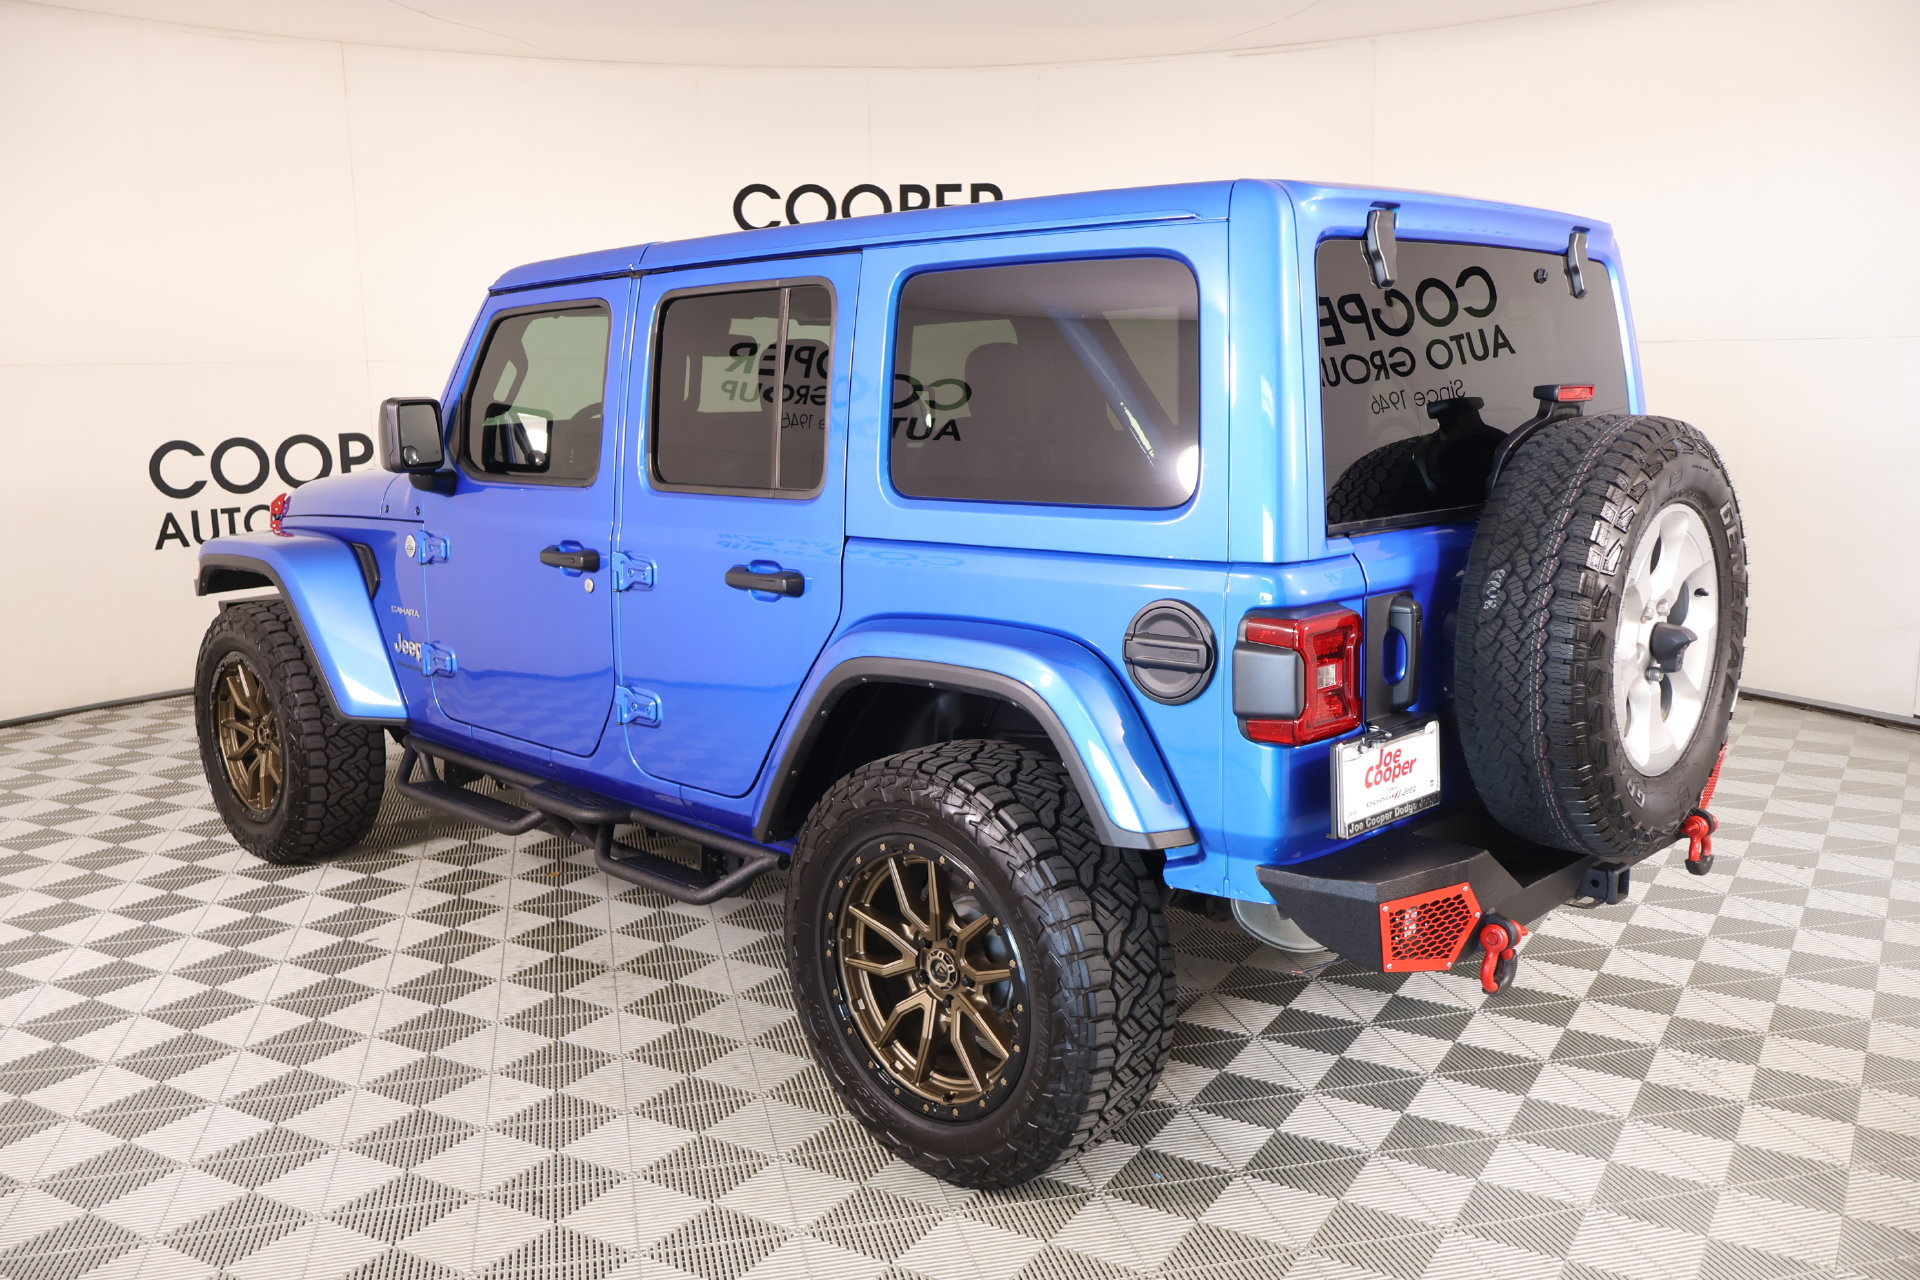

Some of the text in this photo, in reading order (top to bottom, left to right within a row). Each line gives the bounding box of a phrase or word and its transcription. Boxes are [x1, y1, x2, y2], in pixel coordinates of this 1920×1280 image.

[390, 605, 420, 618] SAHARA
[394, 632, 422, 662] Jeep
[1375, 748, 1402, 770] Joe
[1365, 758, 1417, 789] Cooper
[1349, 823, 1364, 834] Joe
[1365, 811, 1393, 828] Cooper
